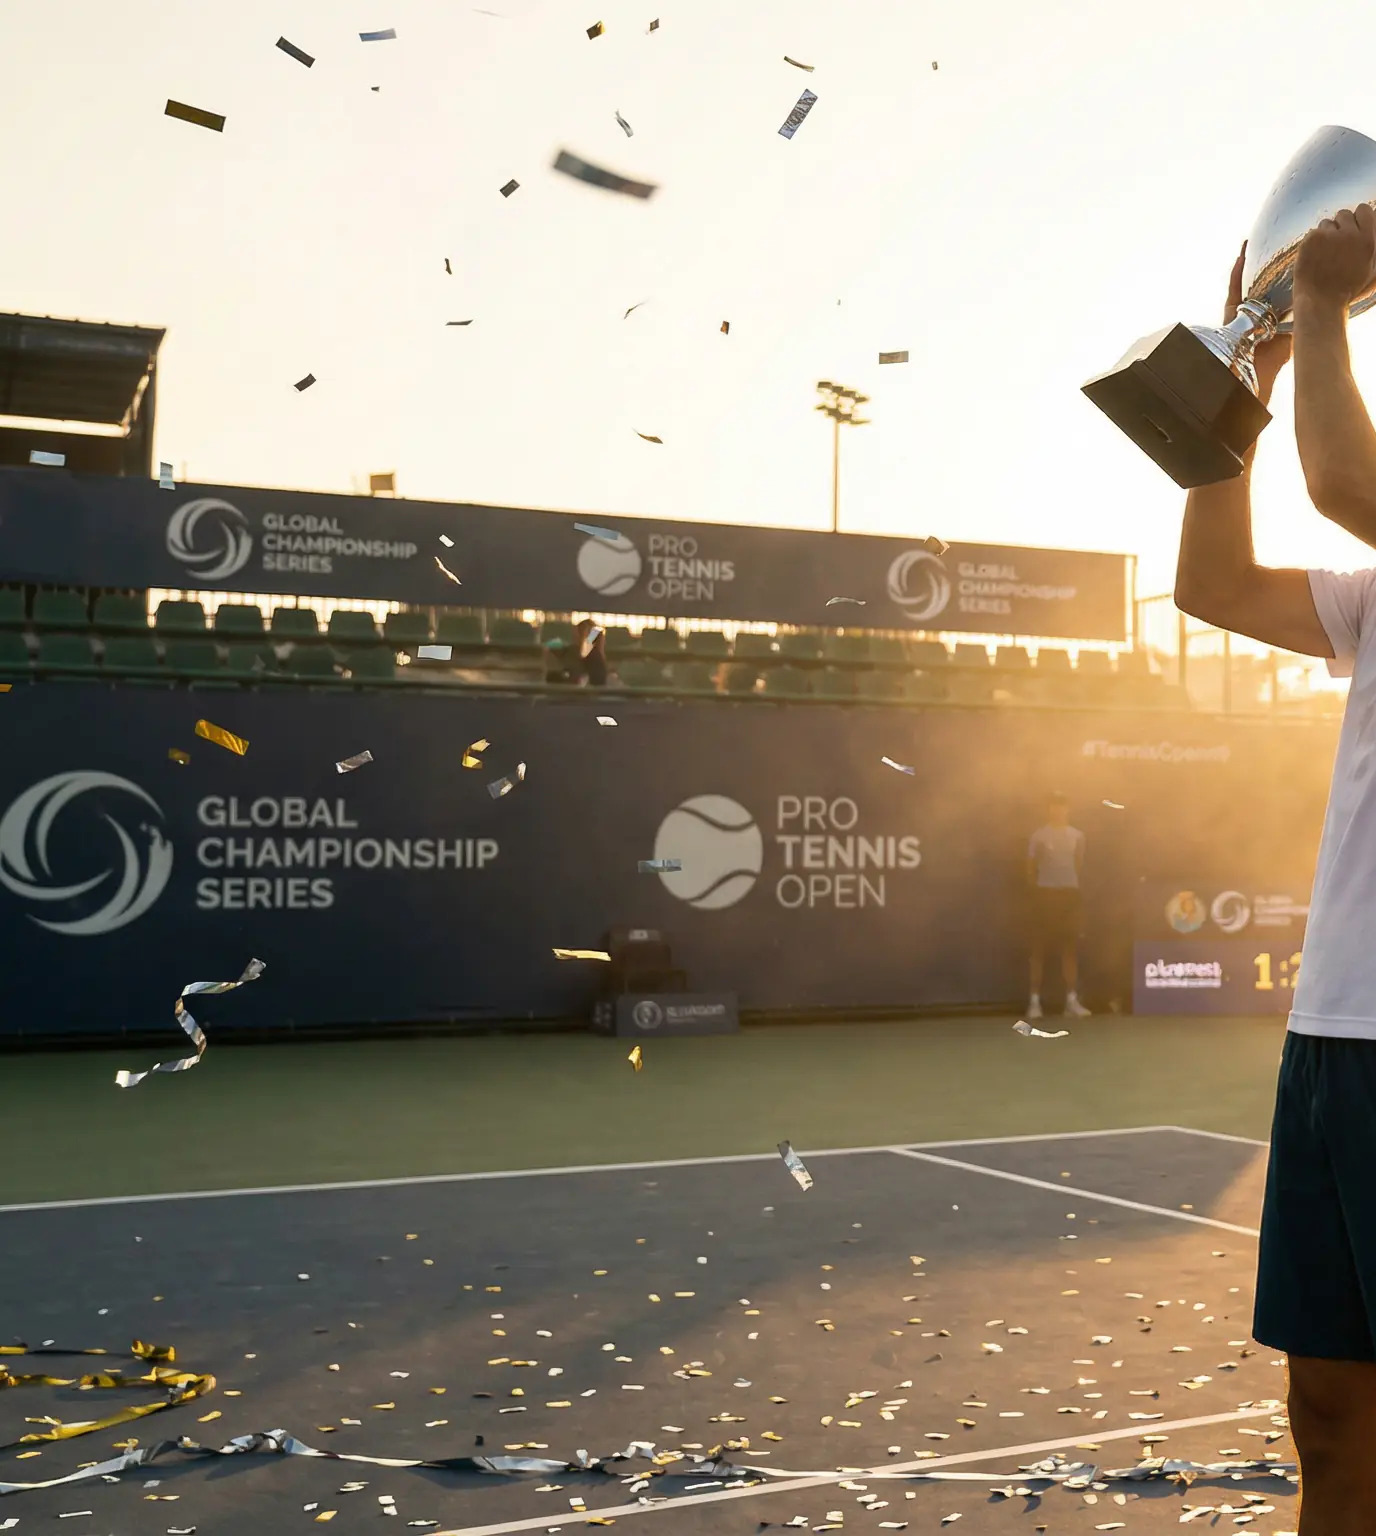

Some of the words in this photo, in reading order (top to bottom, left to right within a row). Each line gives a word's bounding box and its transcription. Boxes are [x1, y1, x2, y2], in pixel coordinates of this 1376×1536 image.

[262, 512, 344, 535] GLOBAL
[262, 533, 418, 559] CHAMPIONSHIP
[649, 533, 698, 557] PRO
[262, 553, 333, 573] SERIES
[648, 556, 735, 581] TENNIS
[648, 579, 714, 601] OPEN
[197, 796, 358, 829] GLOBAL
[777, 795, 858, 831] PRO
[197, 837, 499, 868] CHAMPIONSHIP
[776, 834, 922, 869] TENNIS
[196, 877, 335, 909] SERIES
[776, 874, 885, 908] OPEN
